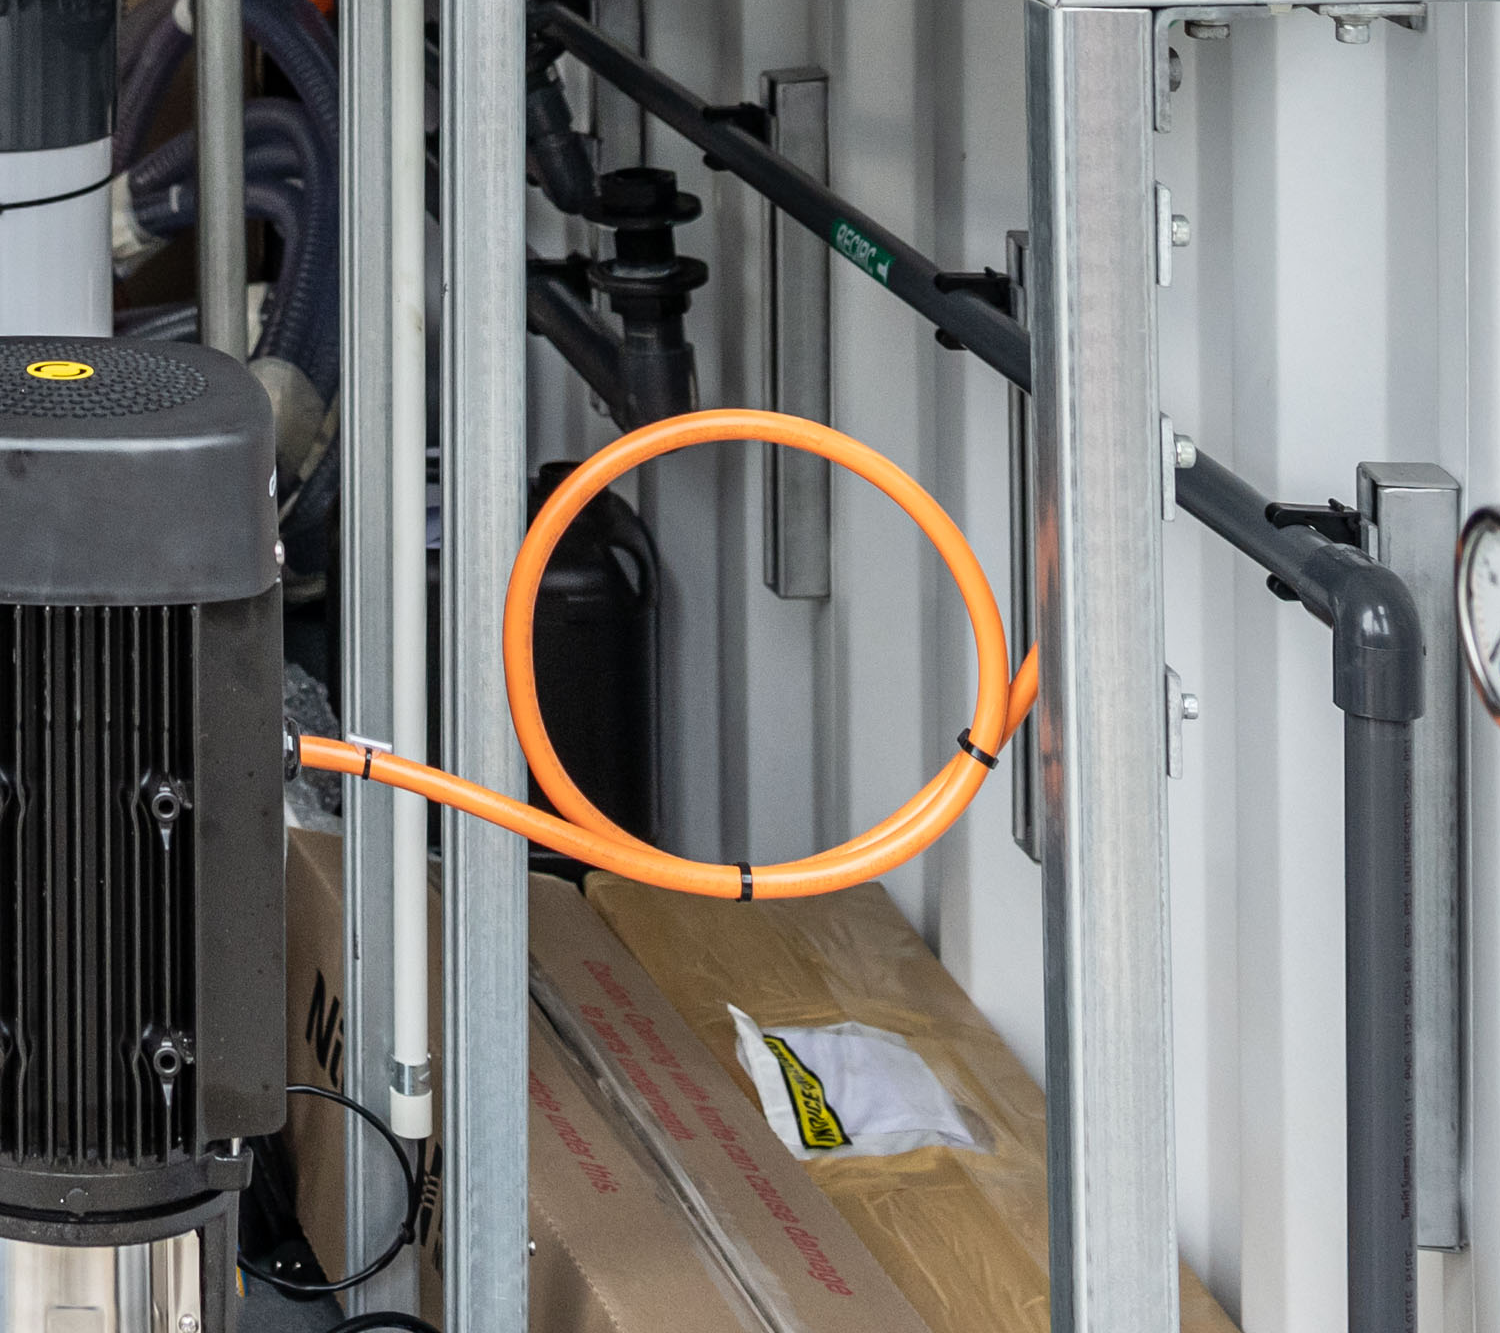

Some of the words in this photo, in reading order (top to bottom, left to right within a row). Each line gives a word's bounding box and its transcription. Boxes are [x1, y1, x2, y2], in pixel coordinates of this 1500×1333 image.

[544, 1113, 597, 1161] under
[624, 1012, 682, 1069] Opening
[670, 1070, 711, 1103] with
[692, 1104, 740, 1143] knife
[721, 1143, 760, 1174] can
[744, 1174, 800, 1225] cause
[781, 1226, 854, 1297] damage
